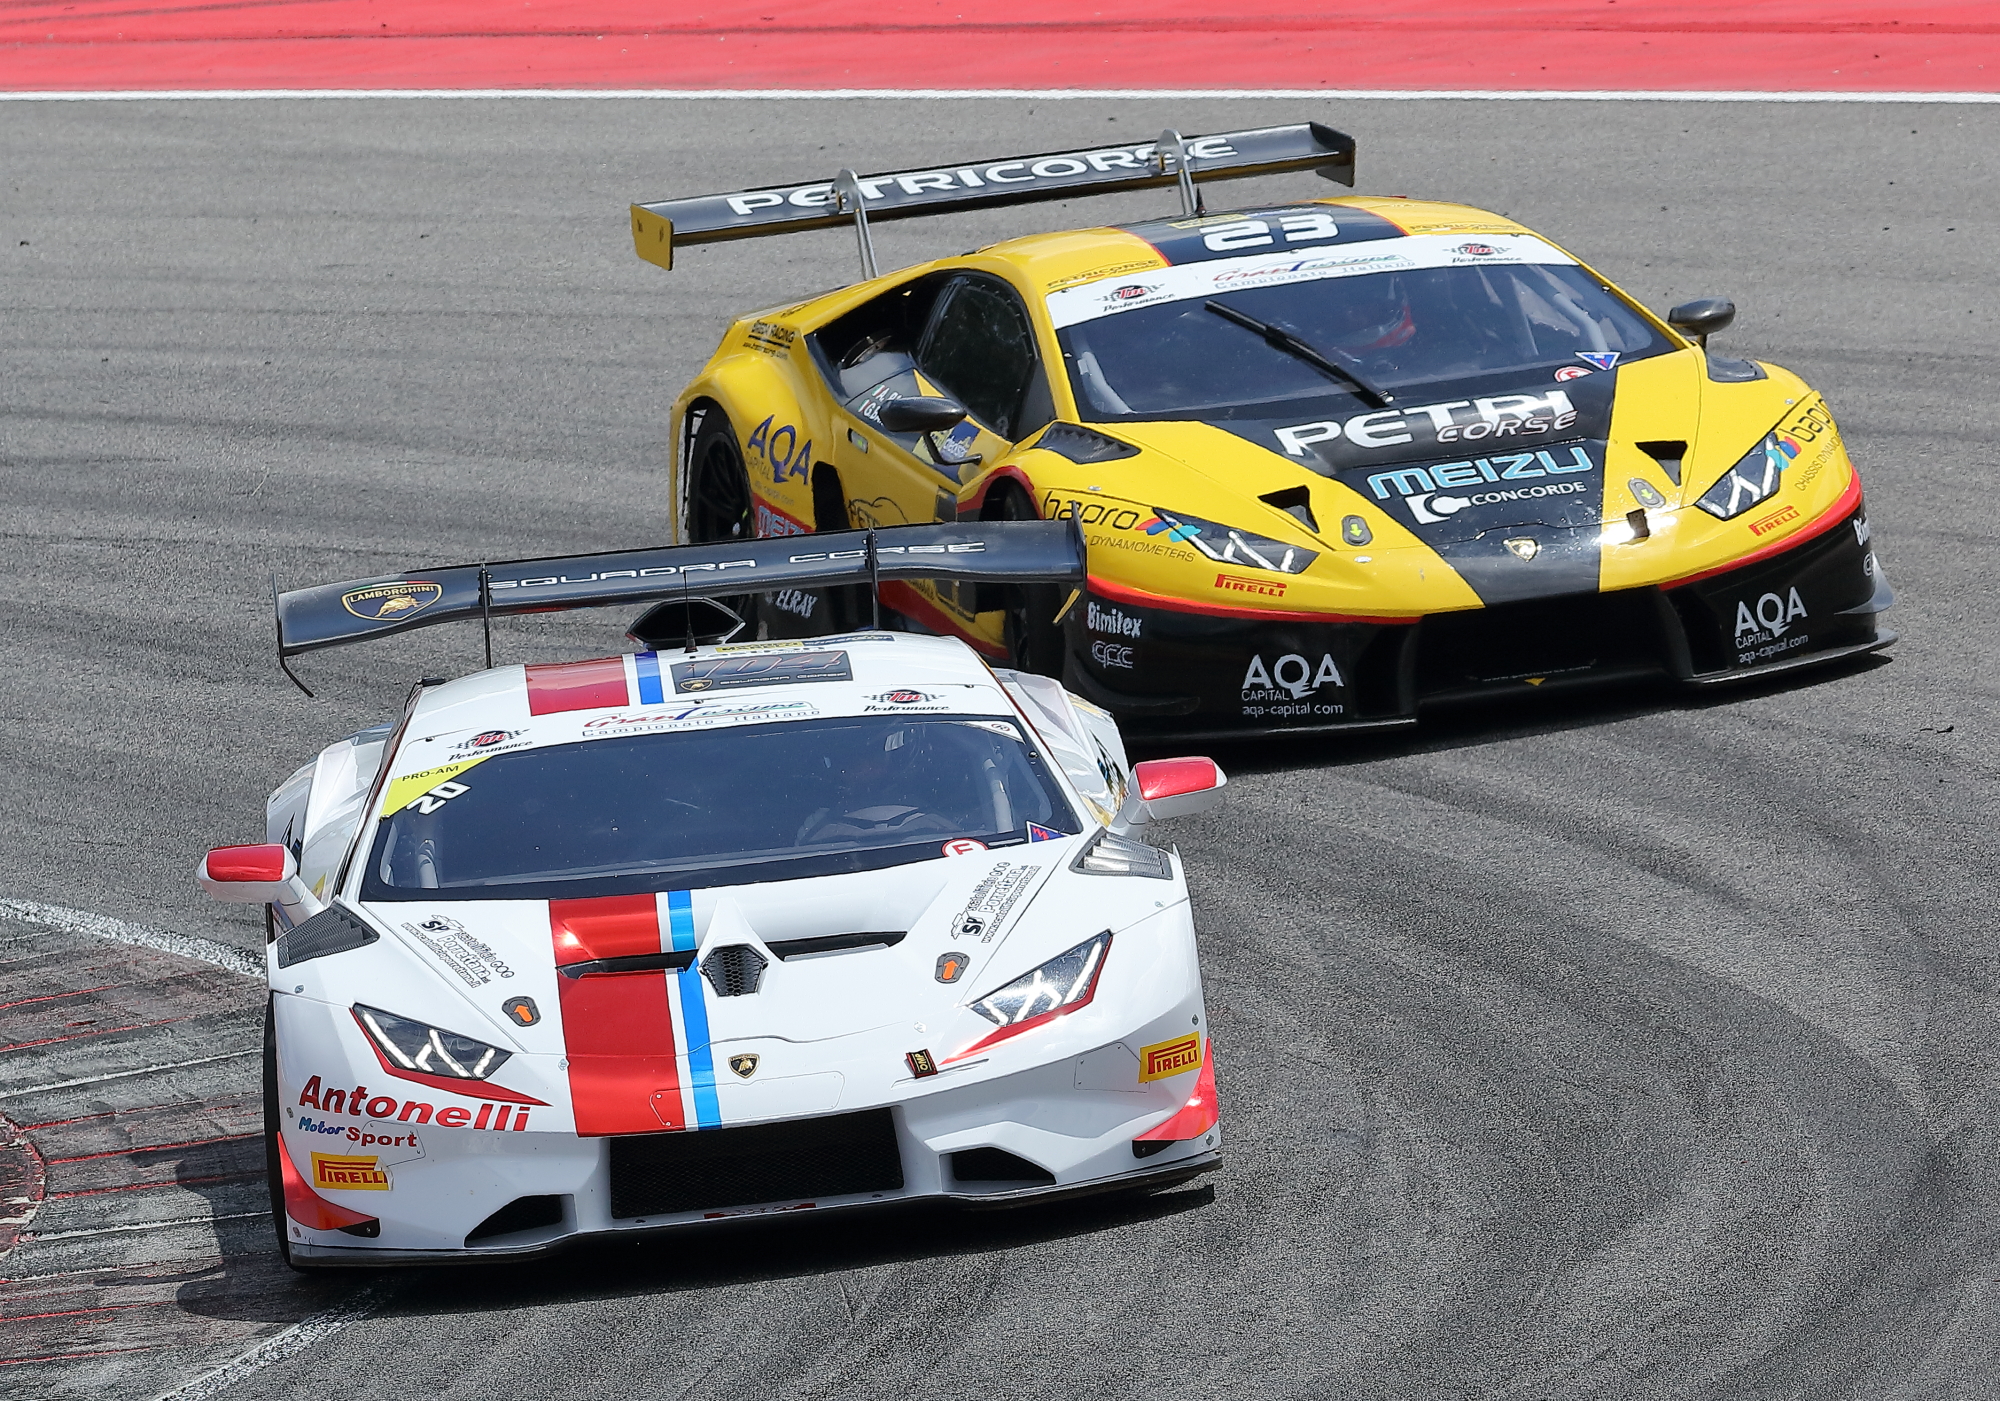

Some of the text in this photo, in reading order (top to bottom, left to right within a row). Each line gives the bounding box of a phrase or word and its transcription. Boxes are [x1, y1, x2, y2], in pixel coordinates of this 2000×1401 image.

[1199, 213, 1339, 251] 23
[1102, 292, 1175, 312] Performance
[1273, 390, 1575, 457] PETRI
[1437, 410, 1579, 443] CORSE
[747, 414, 812, 486] AQA
[1366, 447, 1594, 500] MEIZU
[1794, 460, 1823, 491] CHASSIS
[1471, 481, 1588, 507] CONCORDE
[1748, 505, 1801, 537] PIRELLI
[1090, 535, 1196, 562] DYNAMOMETERS
[488, 541, 986, 589] SQUADRA CORSE
[350, 585, 436, 602] LAMBORGHINI
[1214, 573, 1287, 597] PIRELLI
[1734, 586, 1808, 638] AQA
[1735, 631, 1774, 649] CAPITAL
[1242, 653, 1345, 700] AQA
[863, 704, 950, 712] Performance
[1241, 690, 1290, 701] CAPITAL
[582, 710, 821, 737] Campionato Italiano
[448, 740, 534, 762] Performance
[402, 765, 459, 782] PRO-AM
[406, 780, 472, 815] 20
[437, 934, 491, 980] Porrettana
[914, 1053, 929, 1071] OMP
[1147, 1039, 1198, 1075] PIRELLI
[298, 1074, 531, 1132] Antonelli
[317, 1160, 389, 1184] PIRELLI
